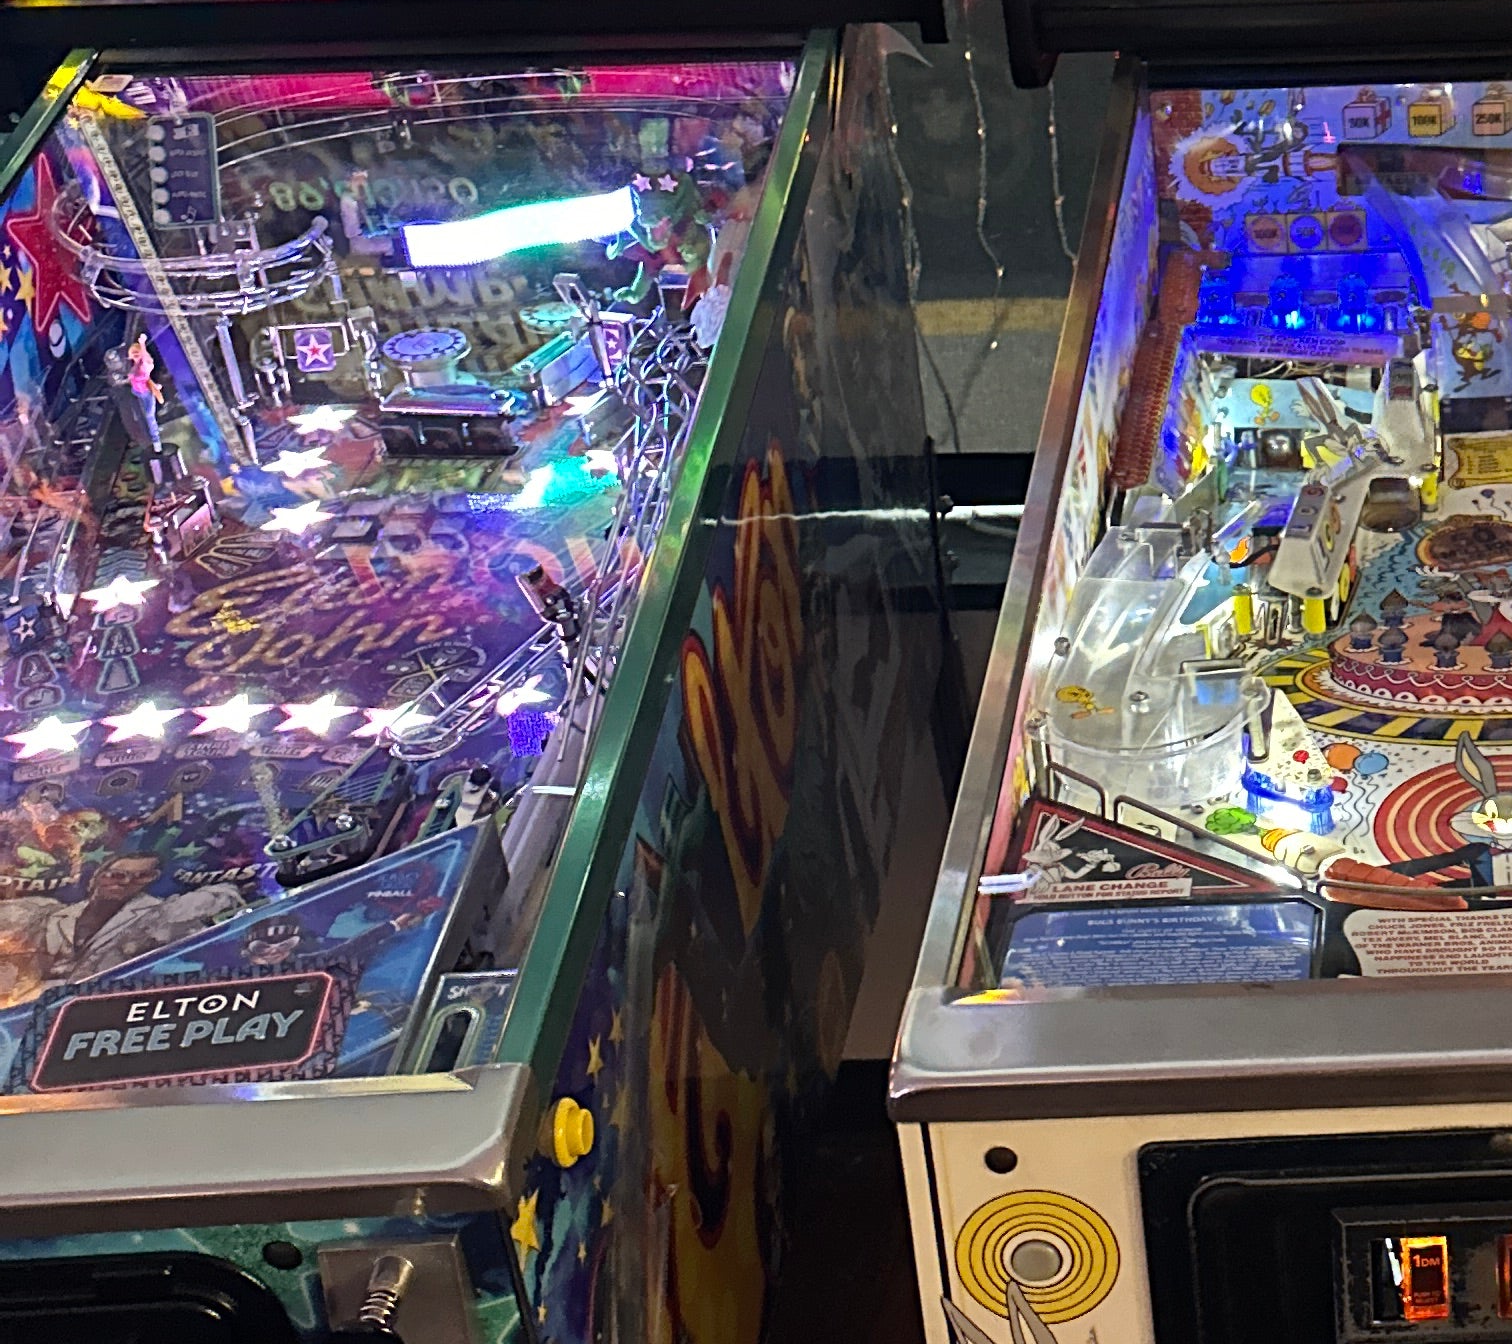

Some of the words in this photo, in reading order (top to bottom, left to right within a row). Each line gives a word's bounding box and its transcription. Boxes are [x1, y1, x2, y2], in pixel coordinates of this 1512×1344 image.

[1124, 862, 1191, 880] Bally
[1052, 883, 1097, 893] LANE
[1099, 881, 1169, 891] CHANGE
[1060, 892, 1094, 900] BUTTON
[1095, 890, 1113, 898] FOR
[1150, 887, 1185, 896] REPORT
[1377, 966, 1453, 974] THROUGHOUT
[126, 990, 260, 1023] ELTON
[63, 1022, 177, 1061] FREE
[179, 1009, 304, 1048] PLAY
[1413, 1254, 1441, 1268] 1DM
